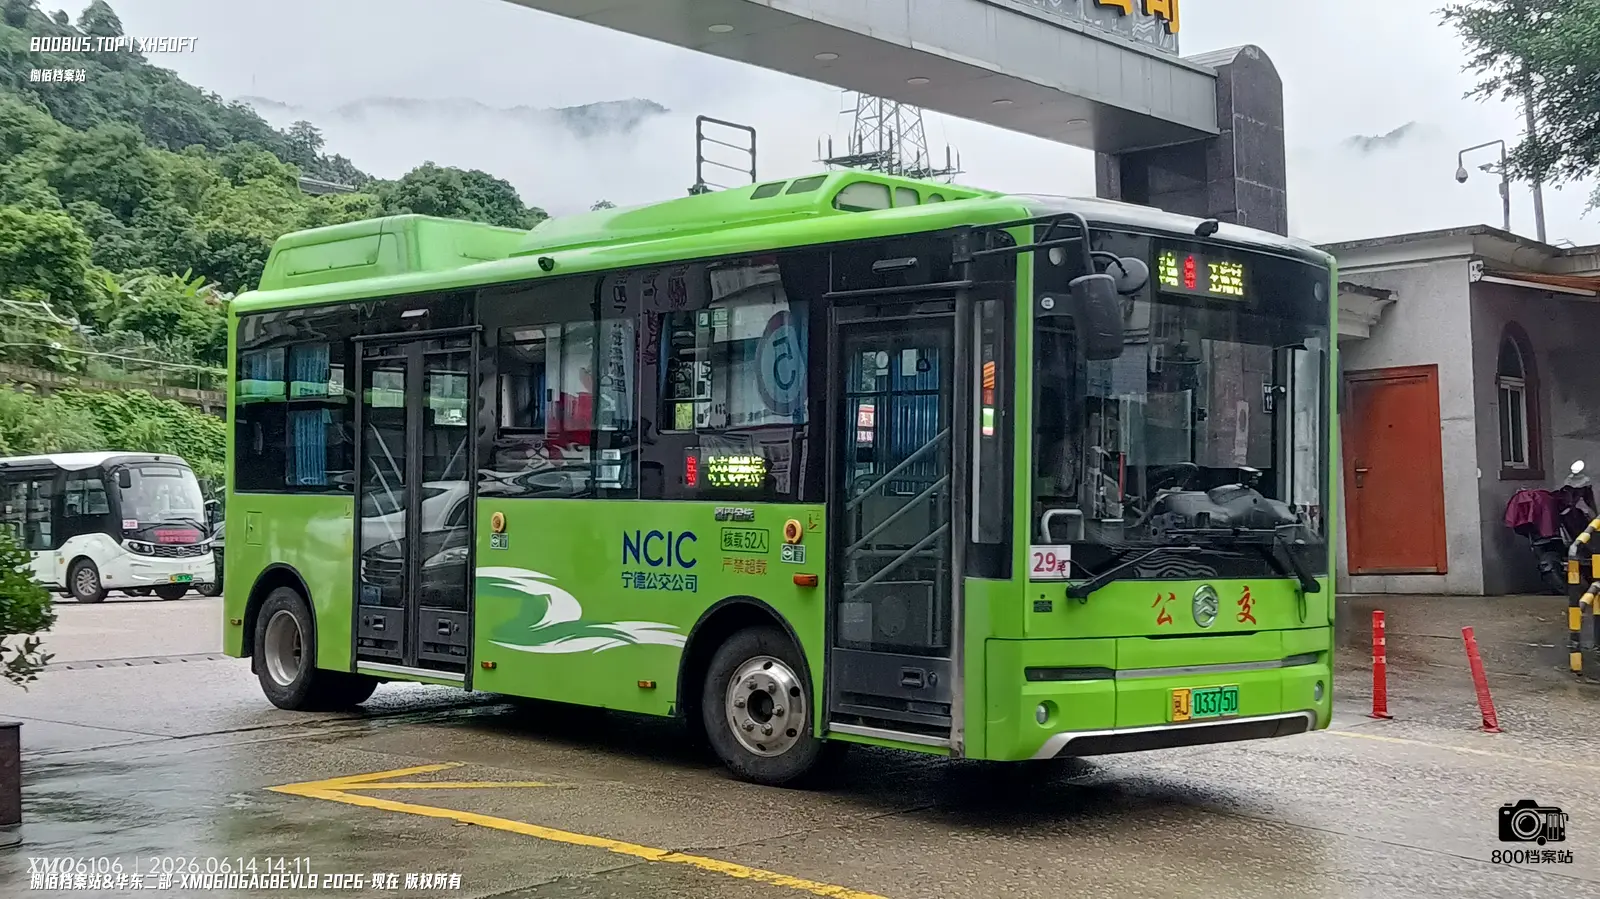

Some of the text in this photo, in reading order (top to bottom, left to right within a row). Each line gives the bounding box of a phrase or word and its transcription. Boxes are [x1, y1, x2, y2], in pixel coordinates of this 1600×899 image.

[622, 530, 697, 568] NCIC
[621, 571, 698, 593] 宁德公交公司
[1151, 586, 1257, 625] 公 交
